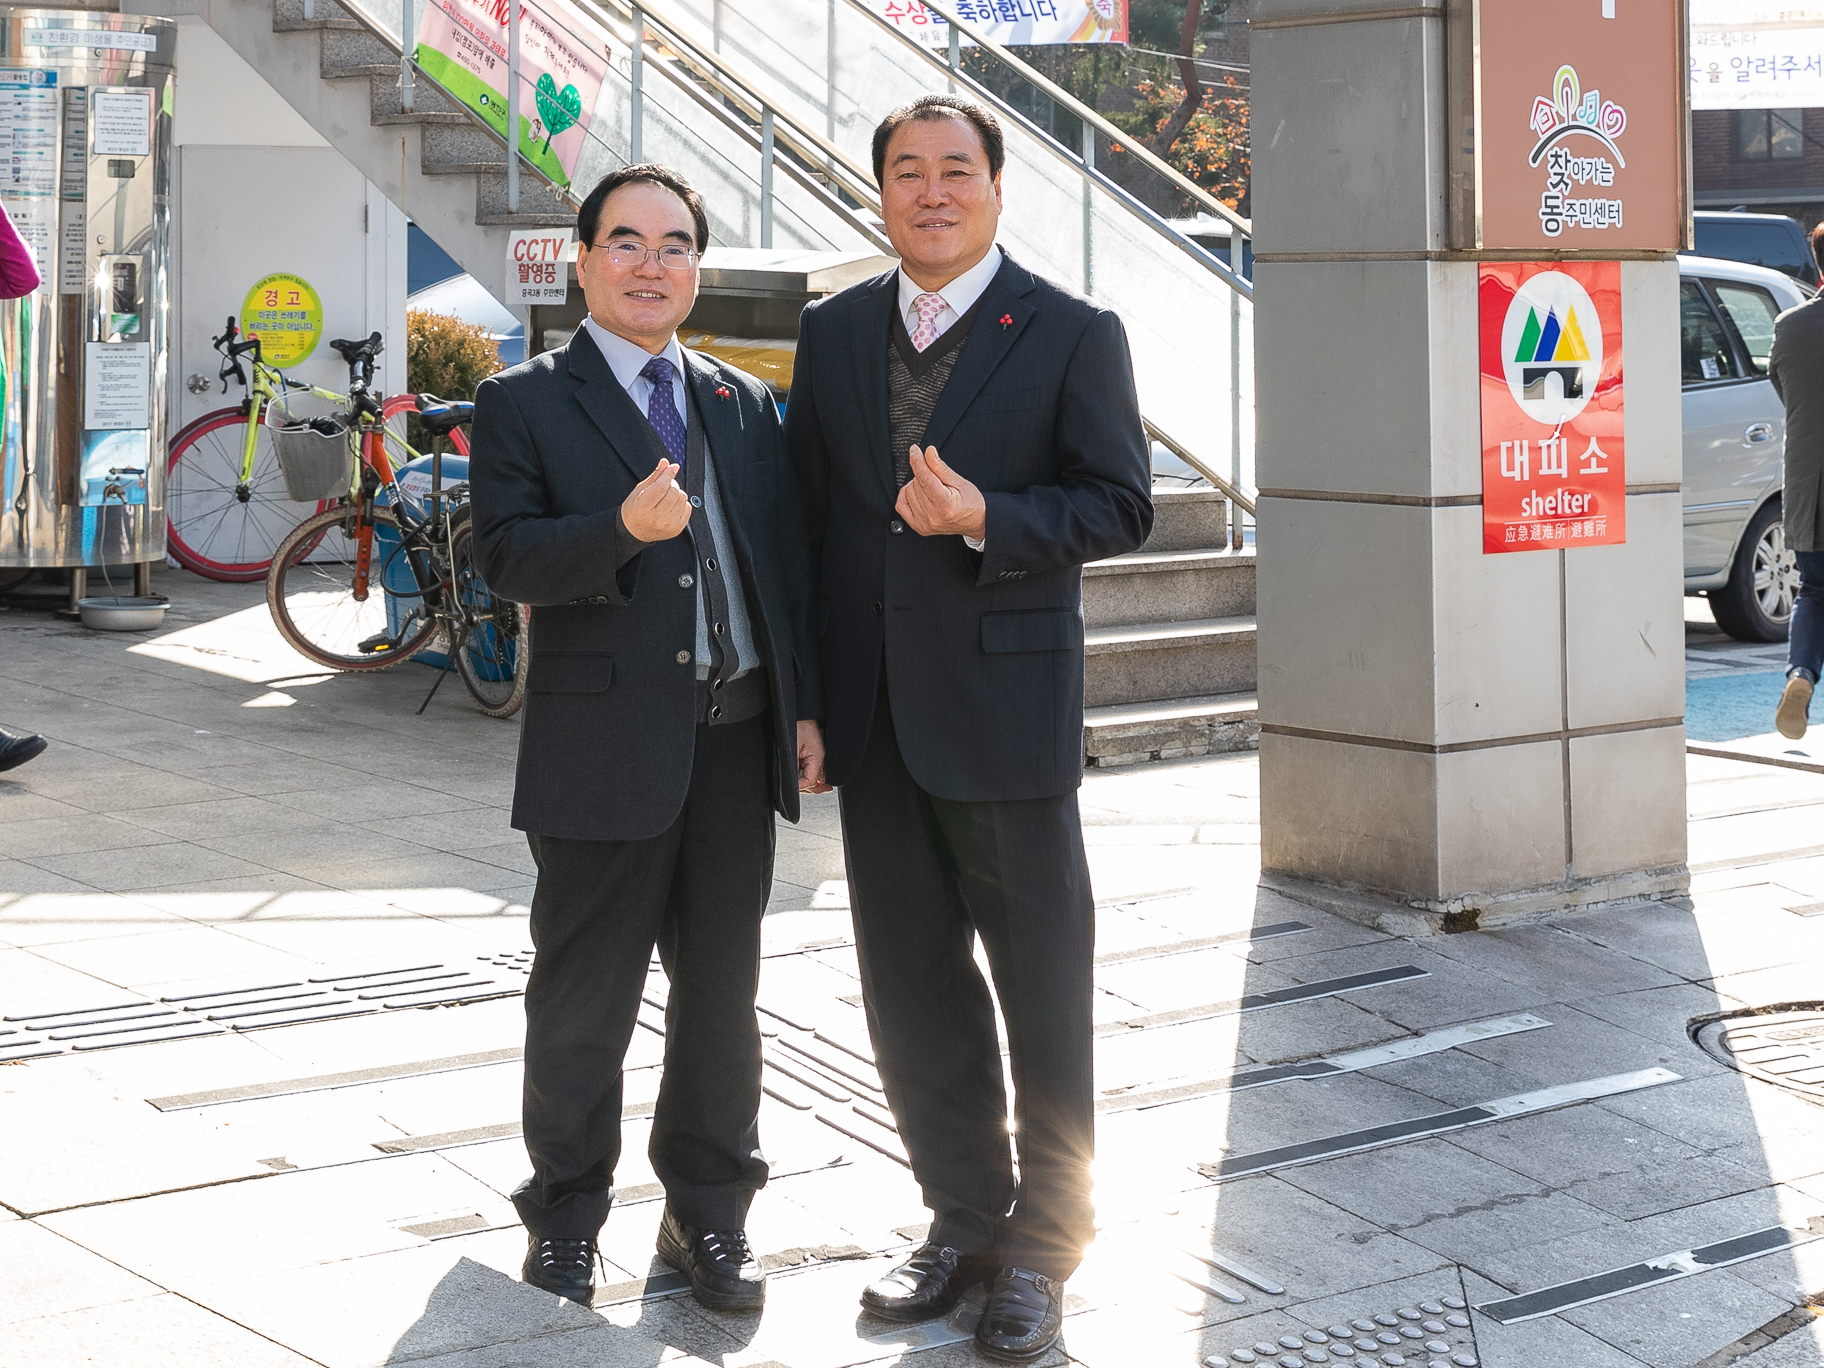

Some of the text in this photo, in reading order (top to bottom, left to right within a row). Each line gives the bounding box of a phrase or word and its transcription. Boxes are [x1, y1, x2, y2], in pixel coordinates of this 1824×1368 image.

[48, 32, 80, 43] 친환경
[84, 33, 113, 45] 미생물
[1548, 150, 1613, 192] 찾아가는
[513, 238, 565, 262] CCTV
[518, 262, 557, 285] 촬영중
[521, 288, 565, 298] 중곡3동 주민센터
[249, 322, 270, 331] 버리는
[271, 322, 285, 331] 곳이
[257, 310, 307, 320] 이곳은 쓰레기를
[1500, 436, 1609, 482] 대피소
[1521, 488, 1592, 518] shelter
[1504, 518, 1608, 544] 应急避难所 避難所
